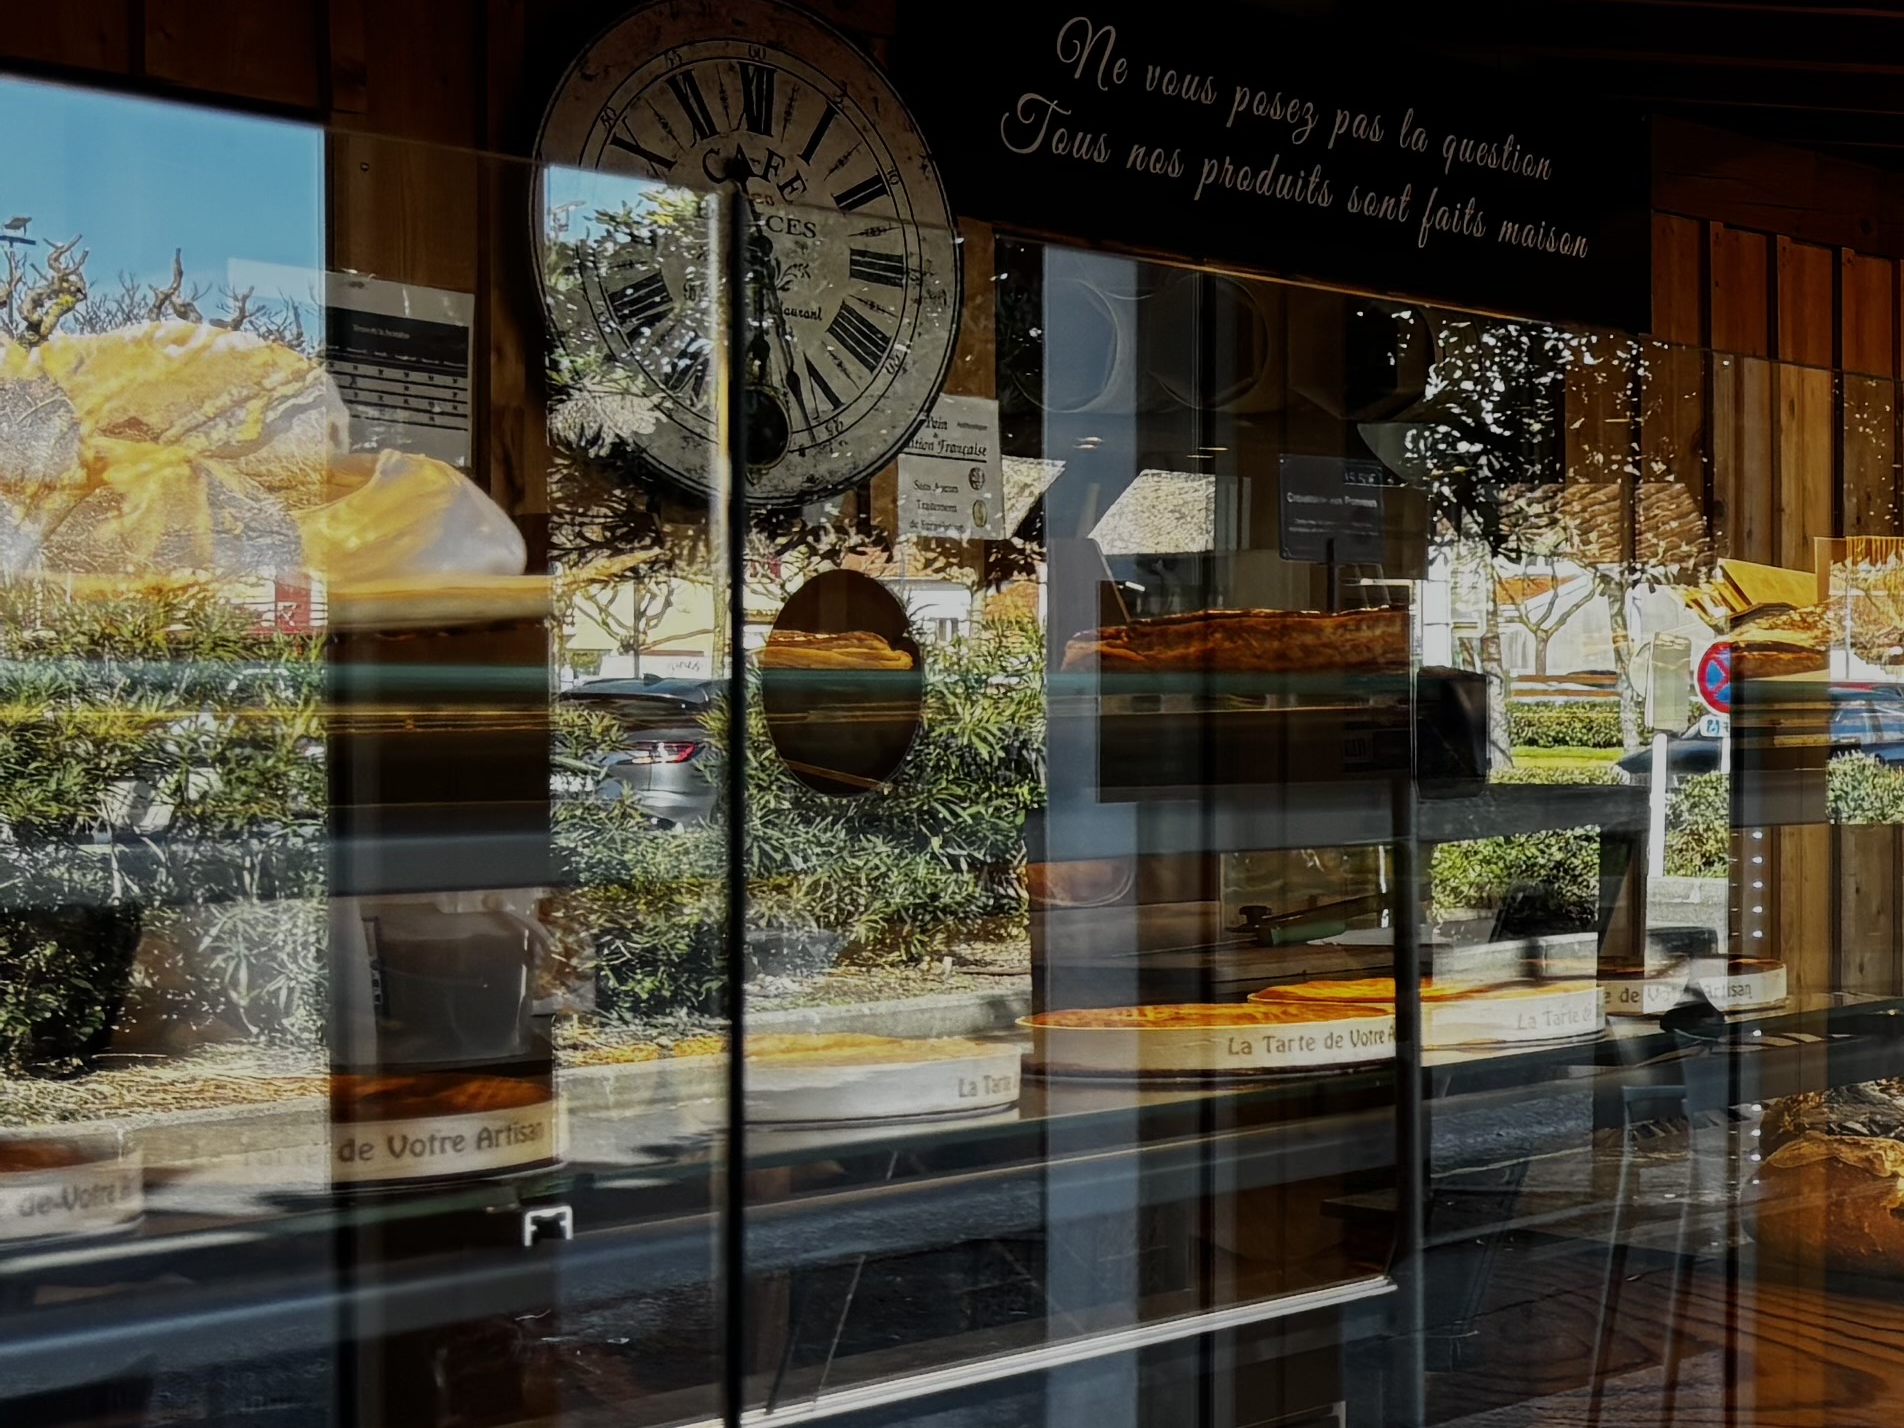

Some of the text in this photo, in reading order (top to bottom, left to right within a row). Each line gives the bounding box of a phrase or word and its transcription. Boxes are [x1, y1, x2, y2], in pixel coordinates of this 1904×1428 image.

[1056, 17, 1552, 180] Ne vous posez pas la question
[1000, 93, 1590, 259] Tous nos produits sont faits maison
[1228, 1036, 1253, 1056] La
[1263, 1035, 1316, 1054] Tarte
[1324, 1032, 1344, 1050] de
[1350, 1028, 1386, 1047] Votre
[337, 1137, 374, 1163] de
[386, 1130, 466, 1160] Votre
